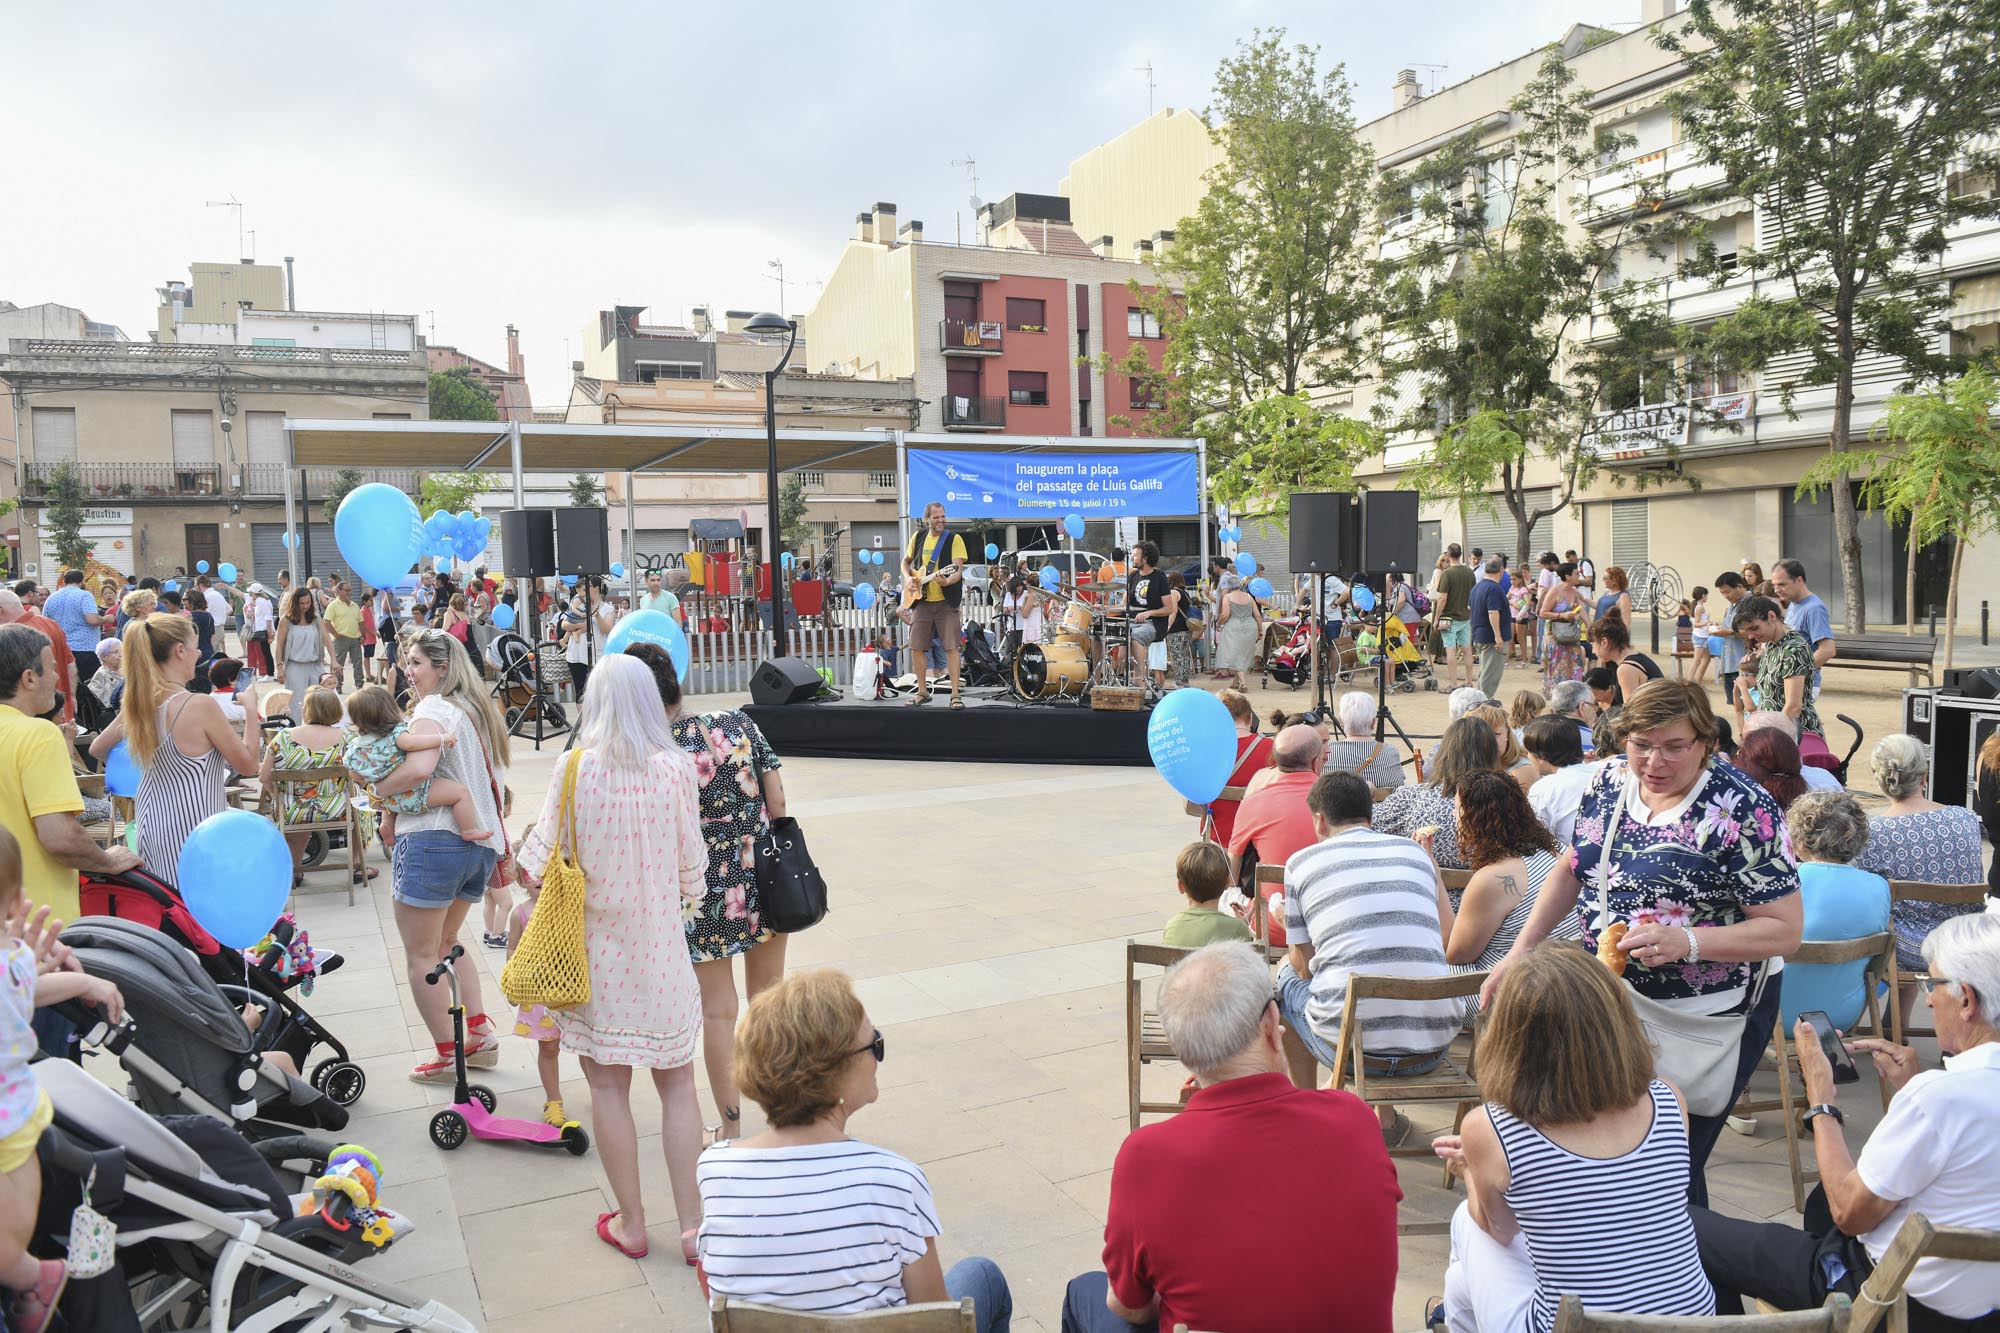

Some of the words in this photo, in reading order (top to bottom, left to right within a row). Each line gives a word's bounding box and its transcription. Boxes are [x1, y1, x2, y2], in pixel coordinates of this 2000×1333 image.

[1016, 463, 1074, 477] Inaugurem
[1077, 463, 1087, 475] la
[1090, 463, 1119, 477] plaça
[1016, 480, 1033, 492] del
[1037, 480, 1083, 494] passatge
[1086, 480, 1099, 491] de
[1102, 480, 1127, 491] Lluís
[1129, 479, 1163, 490] Gallifa
[1018, 498, 1057, 509] Diumenge
[1059, 499, 1069, 507] 15
[1071, 499, 1081, 507] de
[1082, 498, 1101, 509] juliol
[1109, 499, 1119, 507] 19
[1121, 498, 1126, 507] h
[629, 627, 672, 645] Inaugurem
[1171, 725, 1184, 736] del
